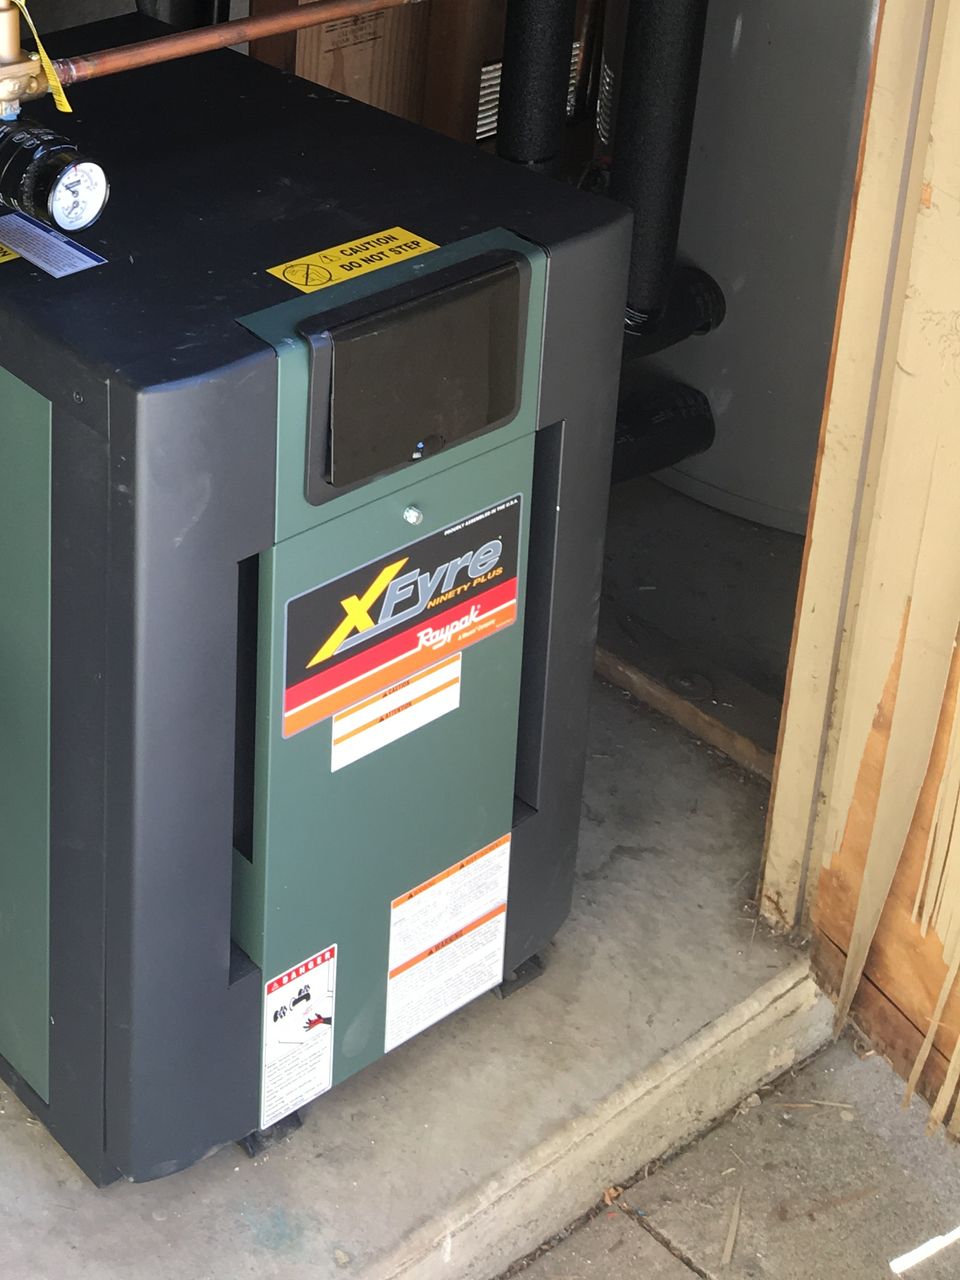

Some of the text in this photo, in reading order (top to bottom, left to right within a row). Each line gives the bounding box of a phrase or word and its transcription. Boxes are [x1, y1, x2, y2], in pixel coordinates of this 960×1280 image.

[340, 233, 400, 257] CAUTION
[340, 239, 423, 272] DO NOT STEP
[426, 566, 504, 609] NINETY PLUS
[416, 605, 481, 651] Raypak
[282, 950, 332, 985] DANGER
